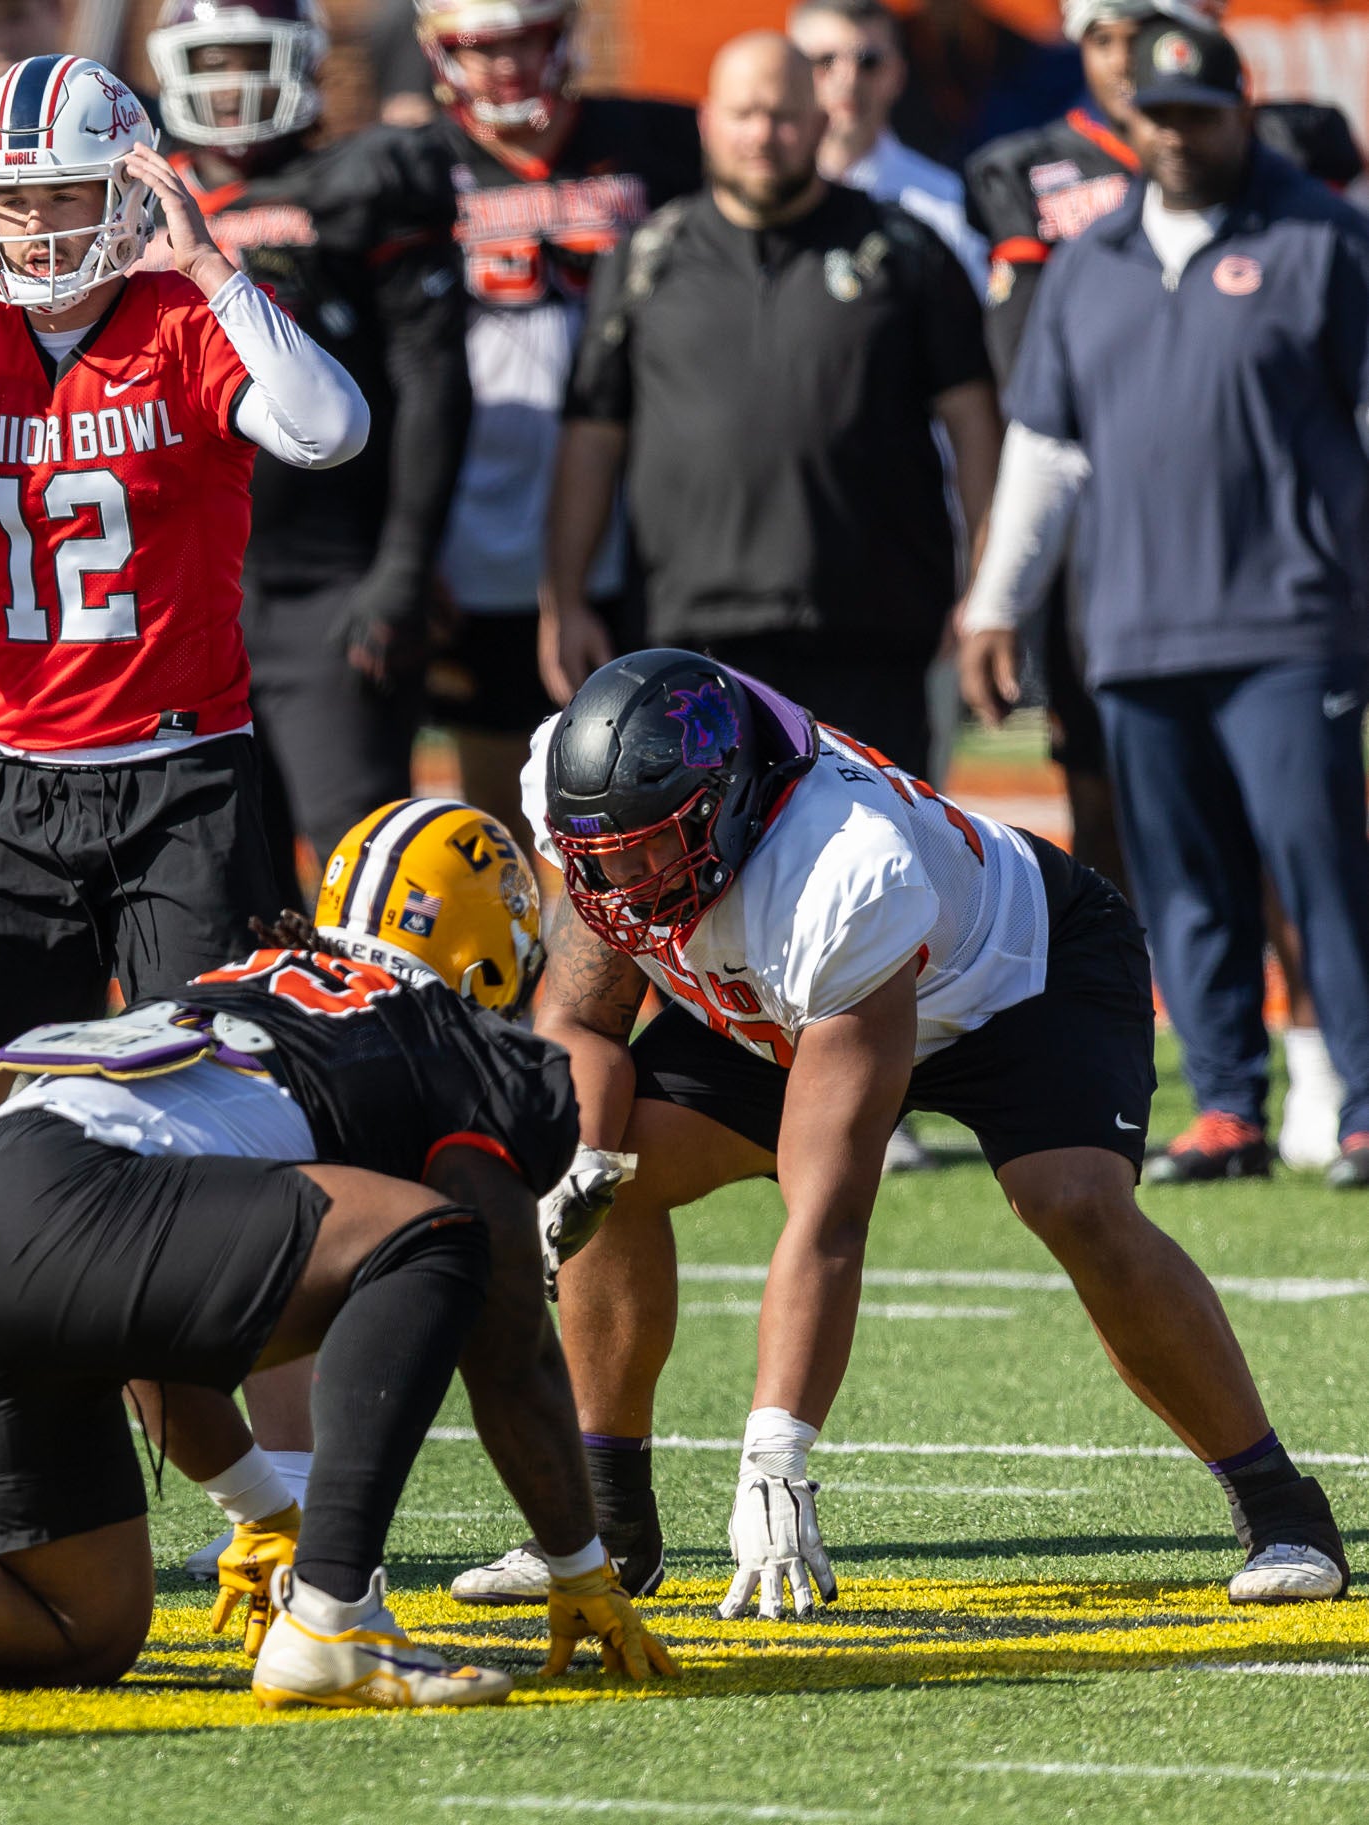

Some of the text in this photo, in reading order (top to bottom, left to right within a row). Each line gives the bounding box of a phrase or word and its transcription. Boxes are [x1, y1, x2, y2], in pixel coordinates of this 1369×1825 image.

[4, 151, 37, 166] MOBILE
[70, 399, 183, 461] BOWL
[171, 713, 183, 727] L
[570, 816, 601, 834] TCU
